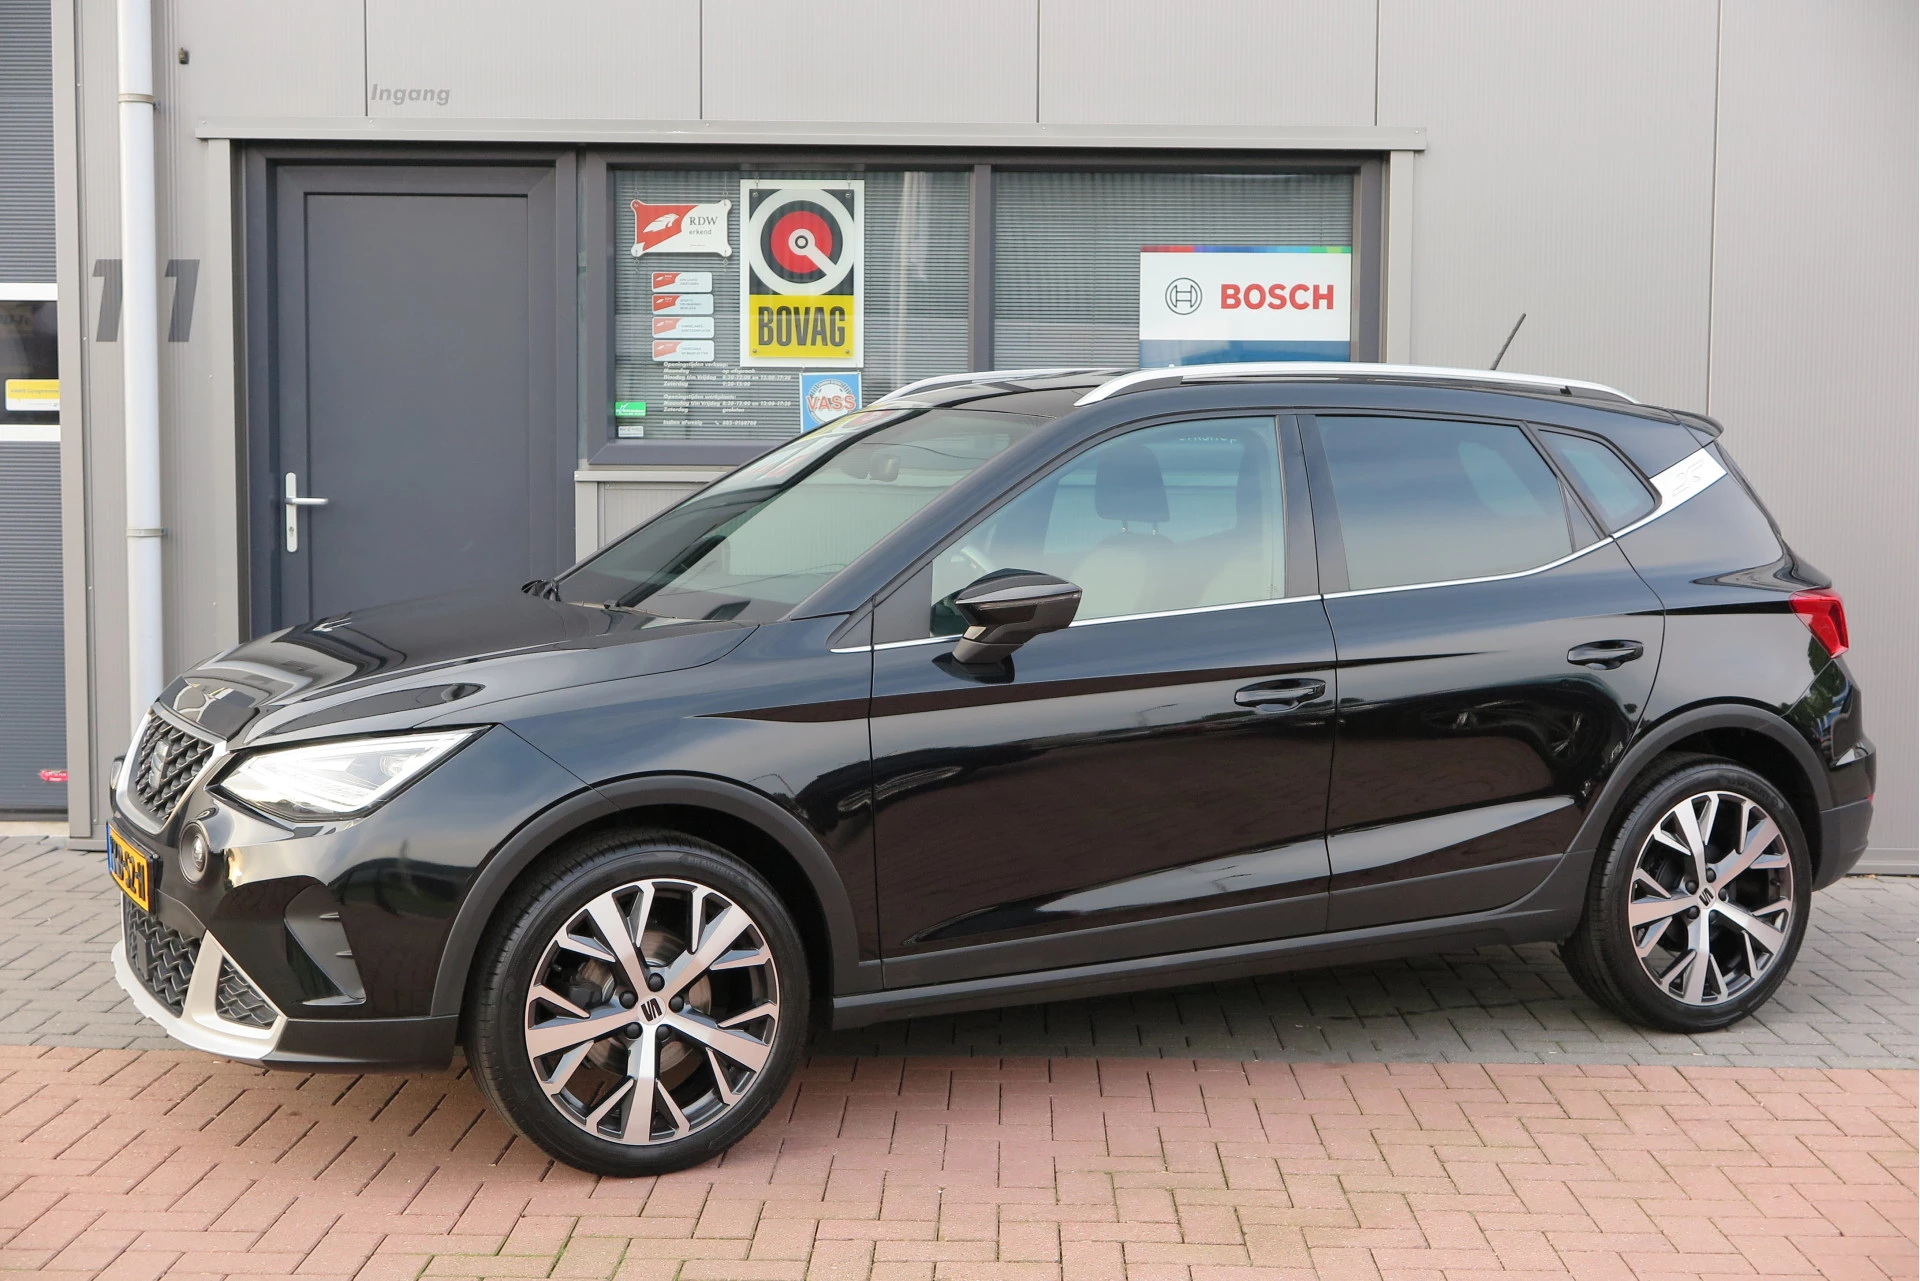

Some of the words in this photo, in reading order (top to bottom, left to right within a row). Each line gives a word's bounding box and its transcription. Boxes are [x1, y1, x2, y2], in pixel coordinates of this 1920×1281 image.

[371, 83, 450, 105] Ingang
[689, 216, 718, 226] RDW
[92, 259, 200, 342] 11
[1221, 283, 1334, 310] BOSCH
[758, 306, 846, 347] BOVAG
[806, 394, 857, 411] VASS
